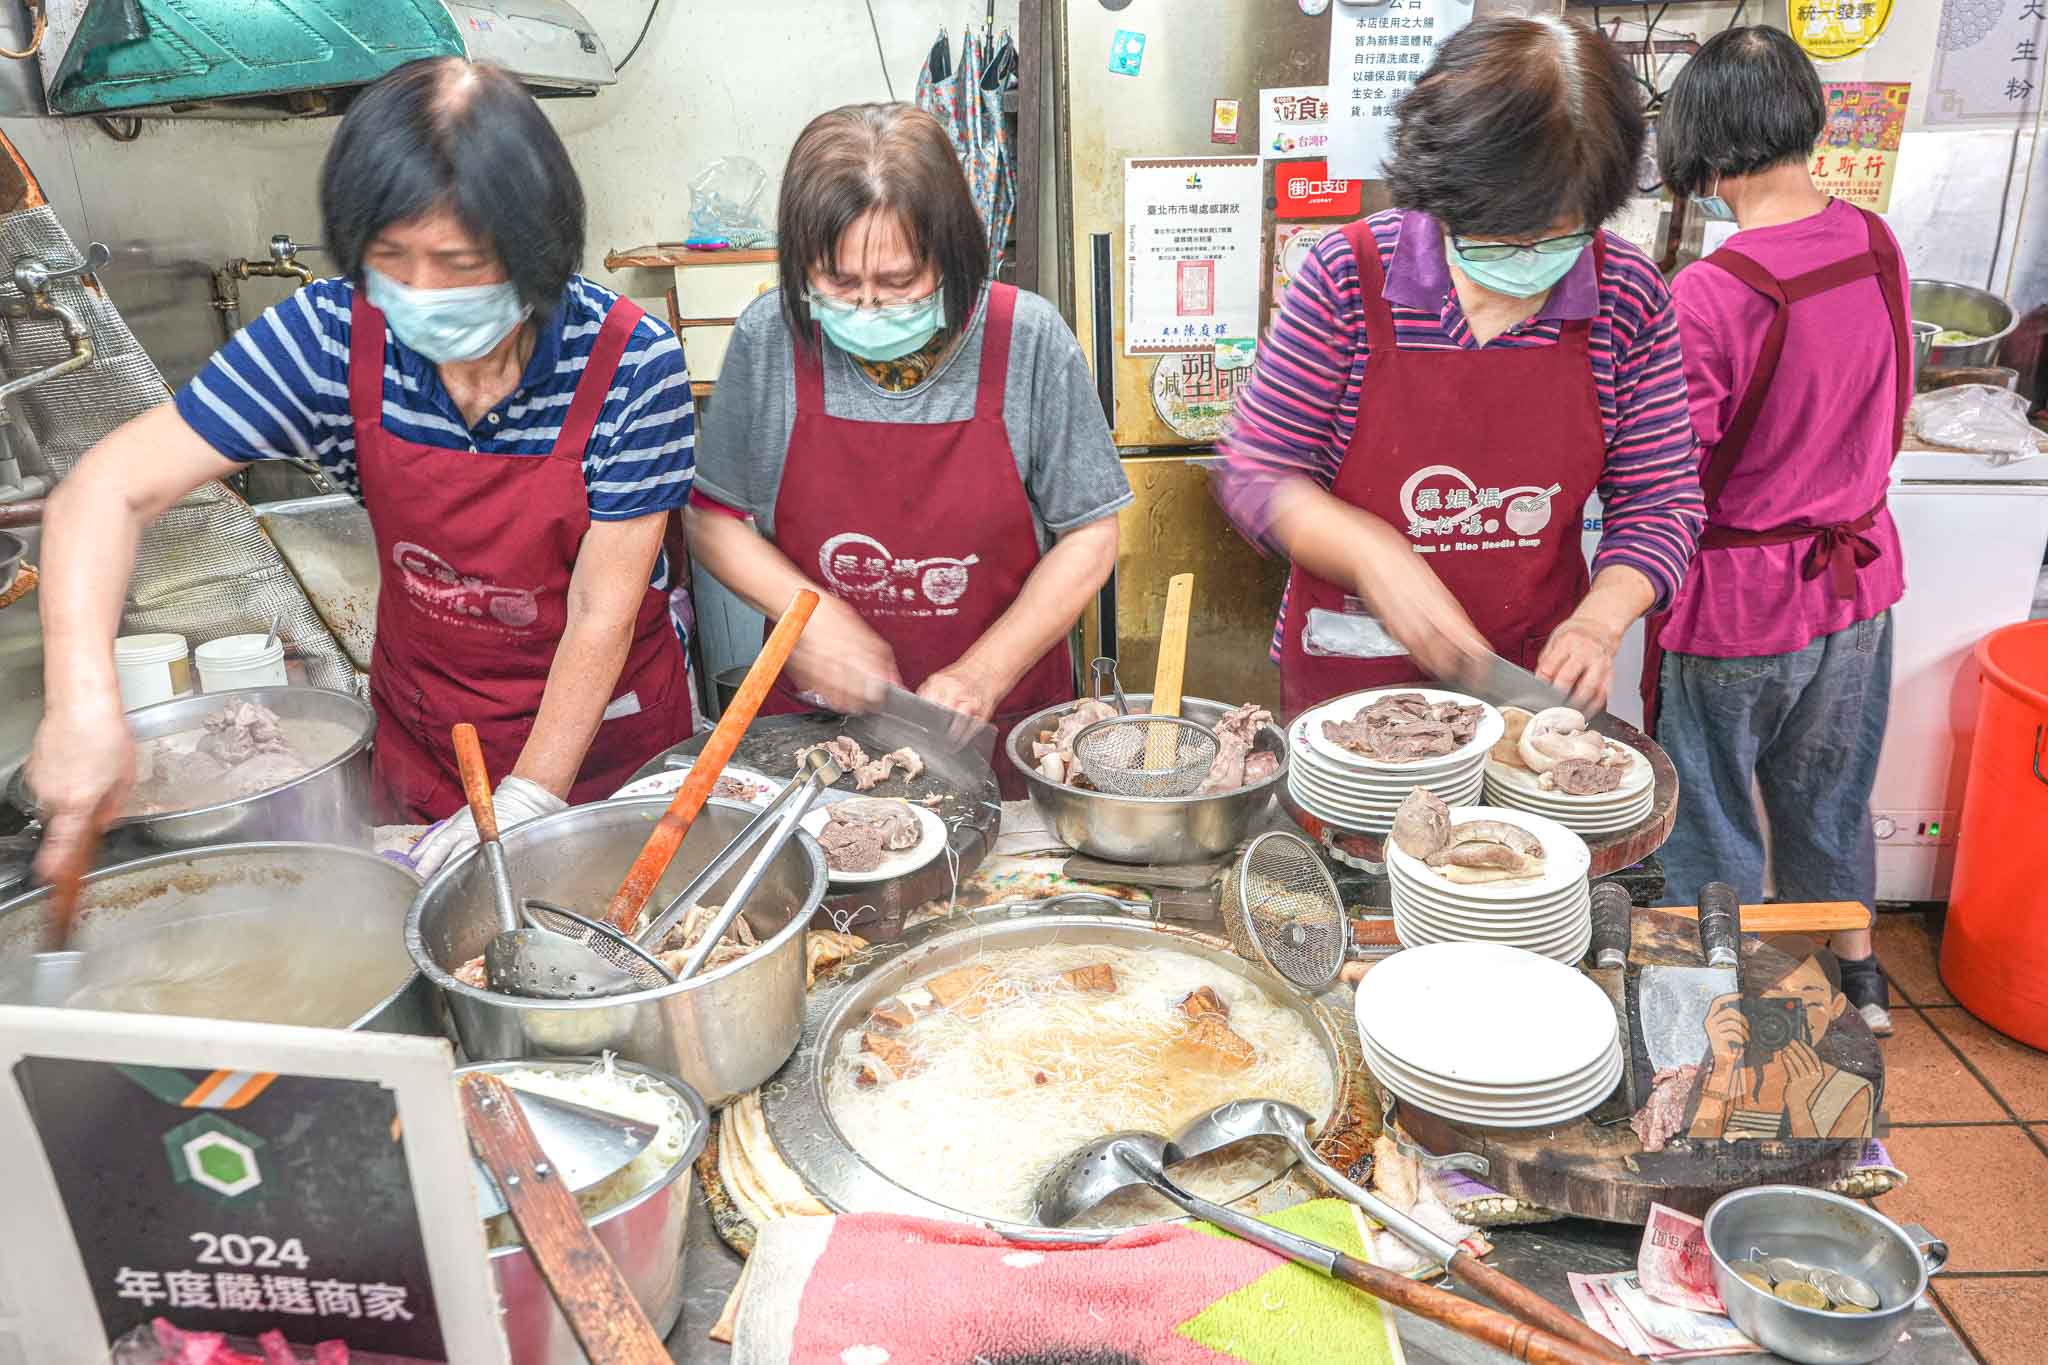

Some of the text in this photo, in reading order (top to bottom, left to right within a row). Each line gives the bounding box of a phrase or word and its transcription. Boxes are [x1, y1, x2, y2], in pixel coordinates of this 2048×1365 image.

[1797, 2, 1875, 20] 統一發票
[1356, 17, 1434, 28] 本店使用之大腸
[1288, 178, 1348, 199] 街口支付
[1147, 204, 1240, 216] 臺北市市場處感謝狀
[1415, 488, 1503, 511] 羅媽媽
[1409, 514, 1483, 537] 米粉湯
[190, 1231, 310, 1269] 2024
[115, 1266, 414, 1321] 年度嚴選商家
